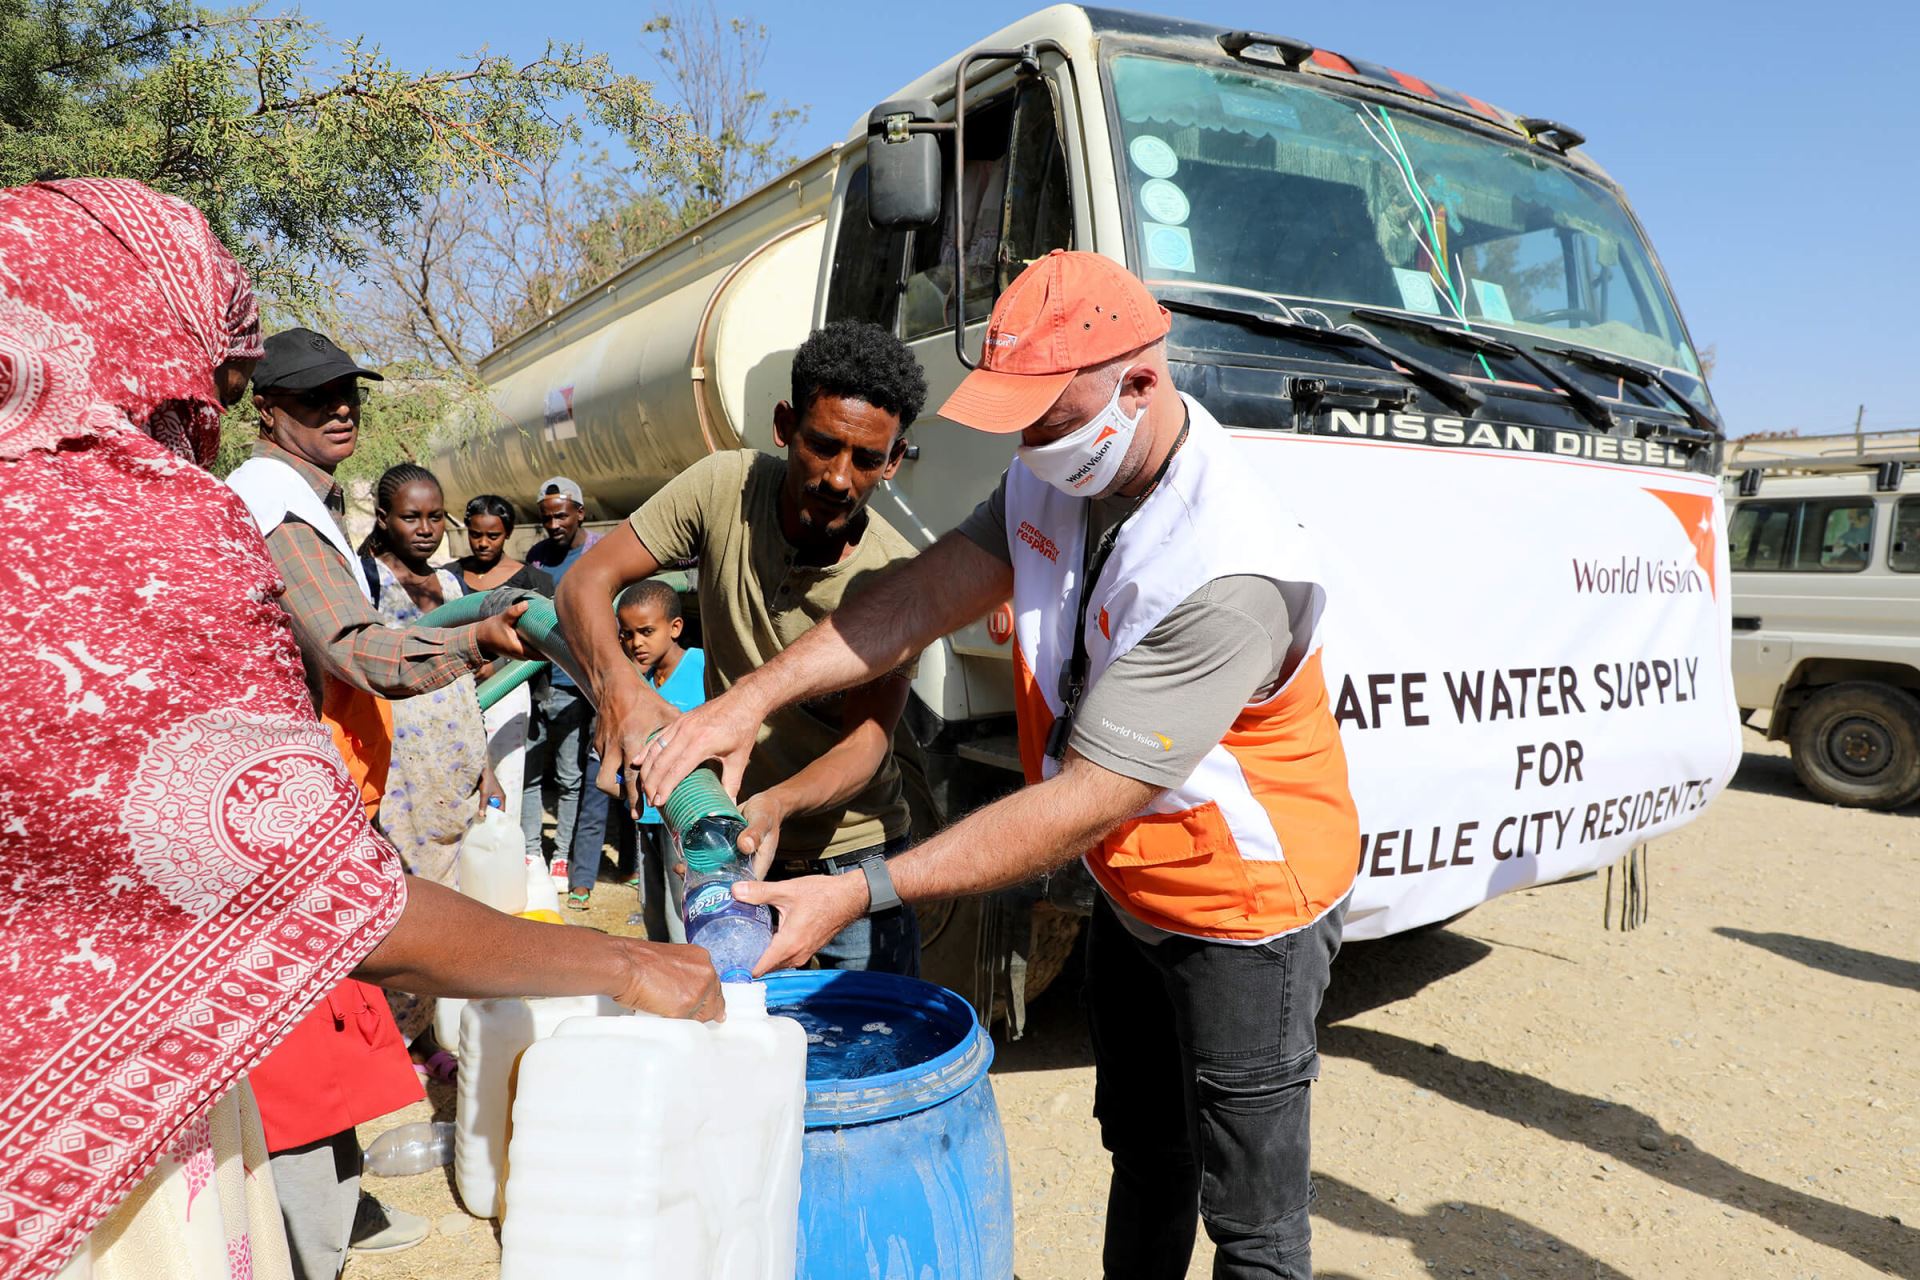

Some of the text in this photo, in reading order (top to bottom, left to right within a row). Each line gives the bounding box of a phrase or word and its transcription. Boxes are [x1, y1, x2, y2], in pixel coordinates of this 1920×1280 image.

[1066, 440, 1112, 483] World Vision
[1331, 408, 1686, 466] NISSAN DIESEL
[1572, 555, 1703, 594] World Vision
[1334, 656, 1699, 730] AFE WATER SUPPLY
[1102, 716, 1160, 749] World Vision
[1514, 739, 1585, 791] FOR
[1492, 807, 1575, 862] CITY
[1579, 777, 1713, 844] RESIDENTS
